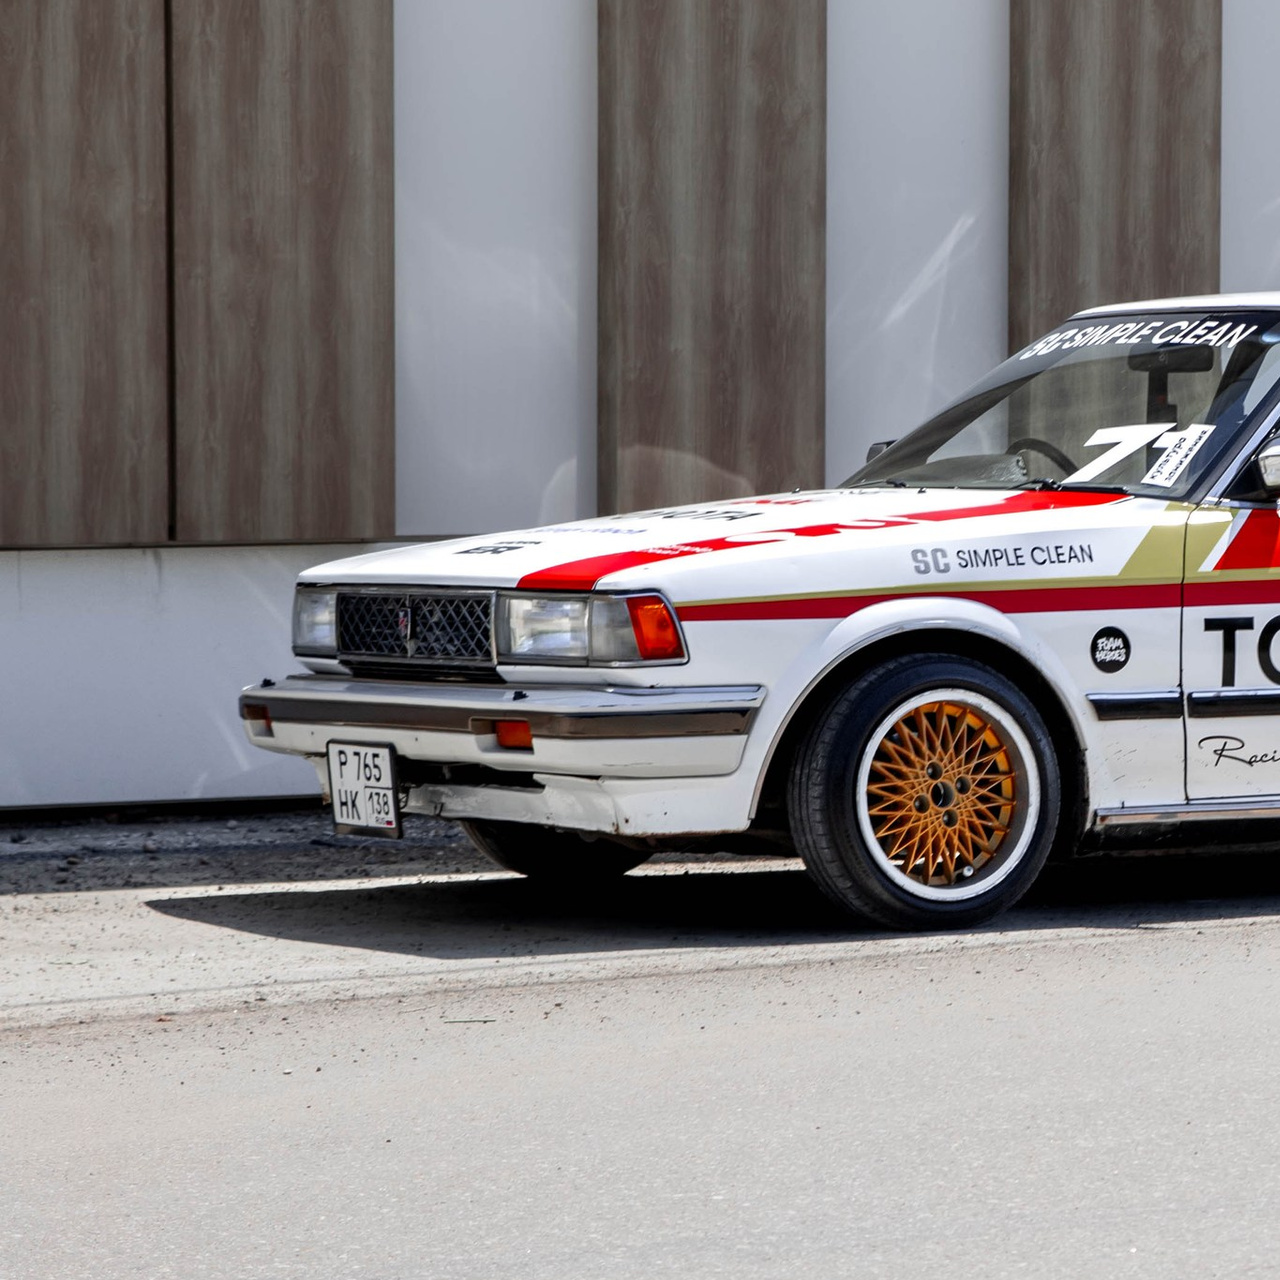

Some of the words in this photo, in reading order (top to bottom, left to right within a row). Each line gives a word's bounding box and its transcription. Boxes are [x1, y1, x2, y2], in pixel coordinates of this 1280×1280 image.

[1019, 329, 1072, 360] SC
[1062, 321, 1164, 350] SIMPLE
[1151, 320, 1258, 349] CLEAN
[1060, 422, 1217, 488] 71
[911, 548, 950, 575] SC
[956, 547, 1026, 569] SIMPLE
[1030, 544, 1094, 566] CLEAN
[1096, 636, 1124, 651] FOAM
[353, 752, 382, 783] 765
[368, 791, 390, 816] 138
